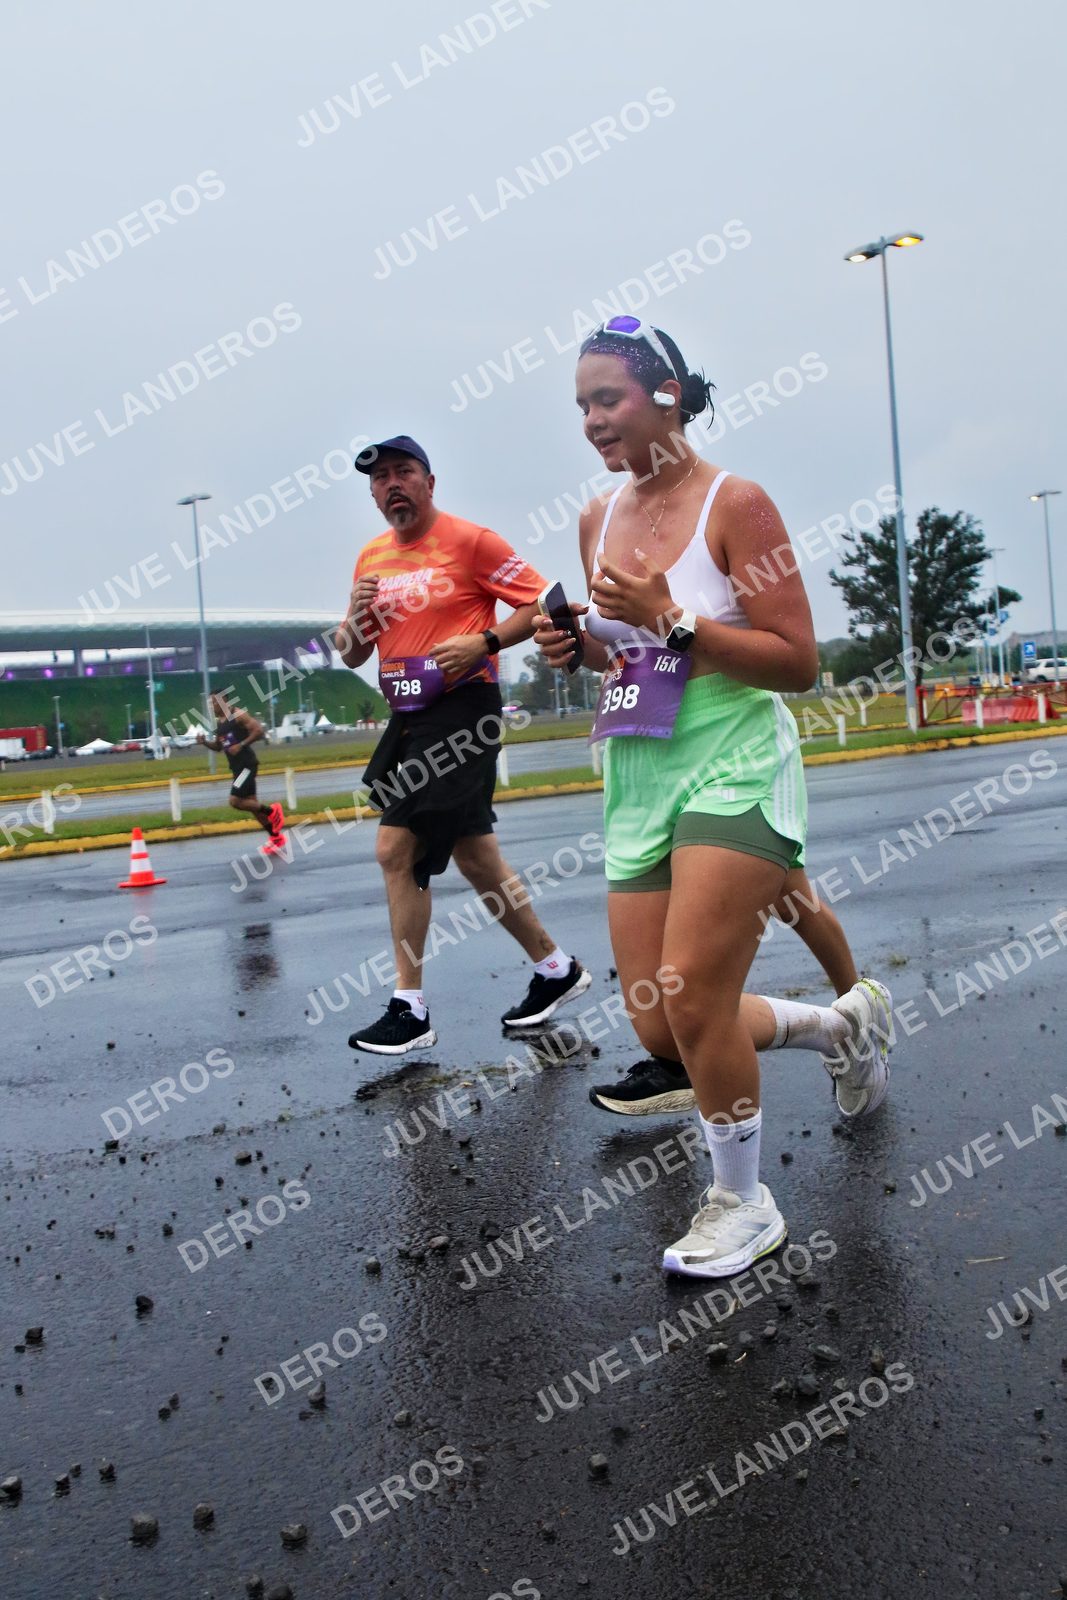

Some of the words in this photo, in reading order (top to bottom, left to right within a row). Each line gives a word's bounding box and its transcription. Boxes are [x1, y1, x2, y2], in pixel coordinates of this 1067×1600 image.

[653, 655, 682, 673] 15K
[392, 679, 422, 697] 798
[601, 684, 641, 715] 398
